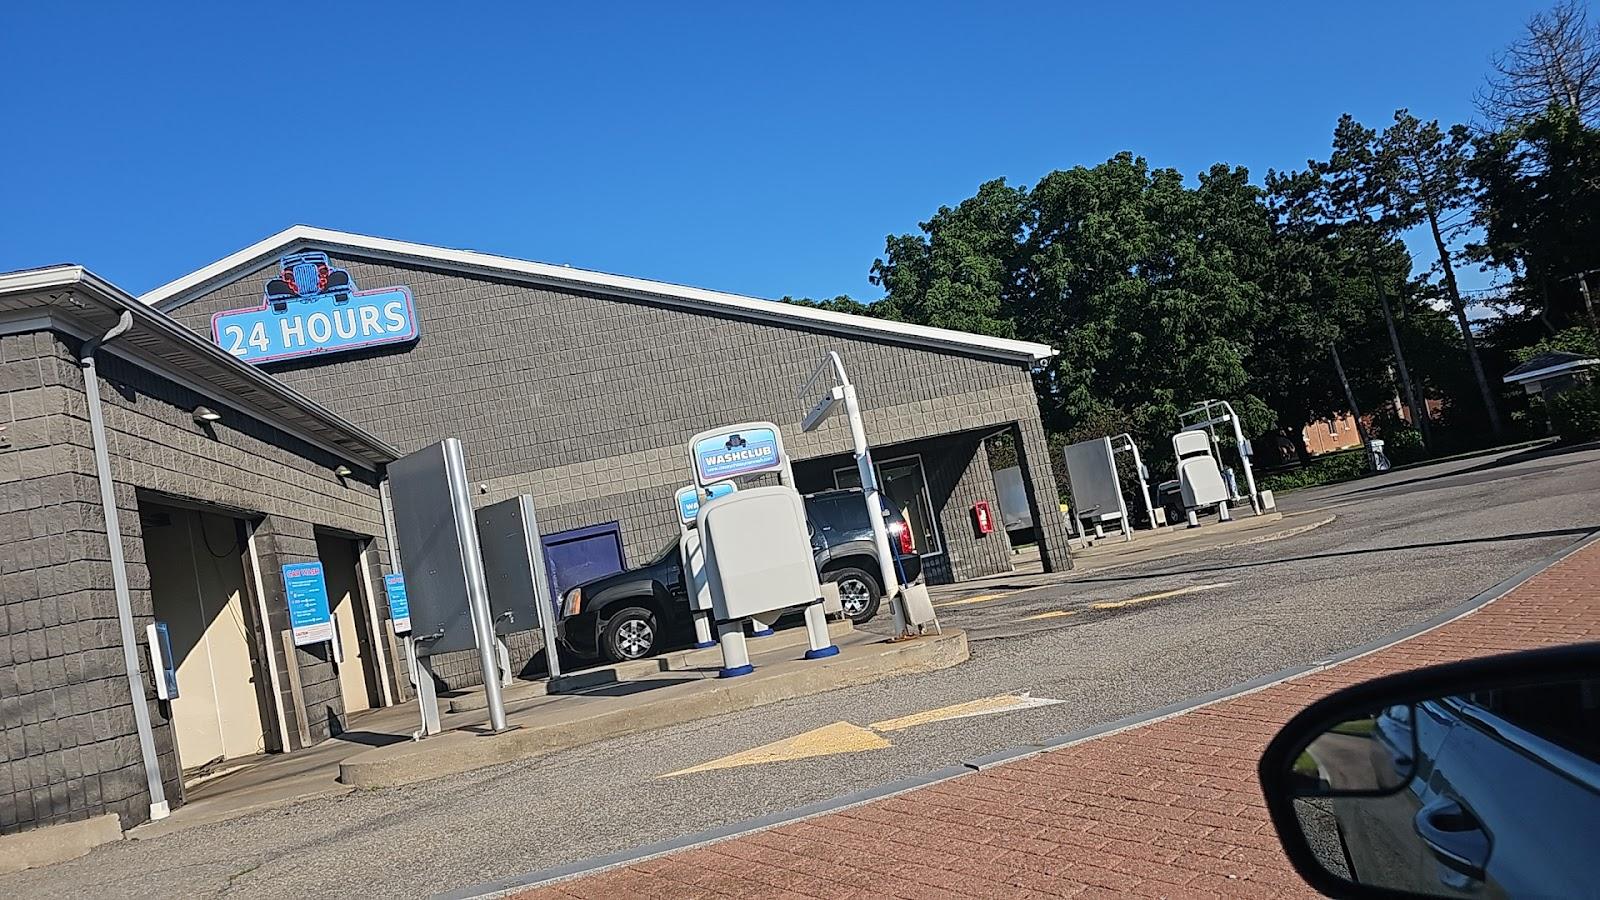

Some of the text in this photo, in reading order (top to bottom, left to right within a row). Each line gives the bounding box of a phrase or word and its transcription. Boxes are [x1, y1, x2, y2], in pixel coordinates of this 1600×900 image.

[224, 302, 406, 356] 24 HOURS
[705, 446, 772, 466] WASHCLUB
